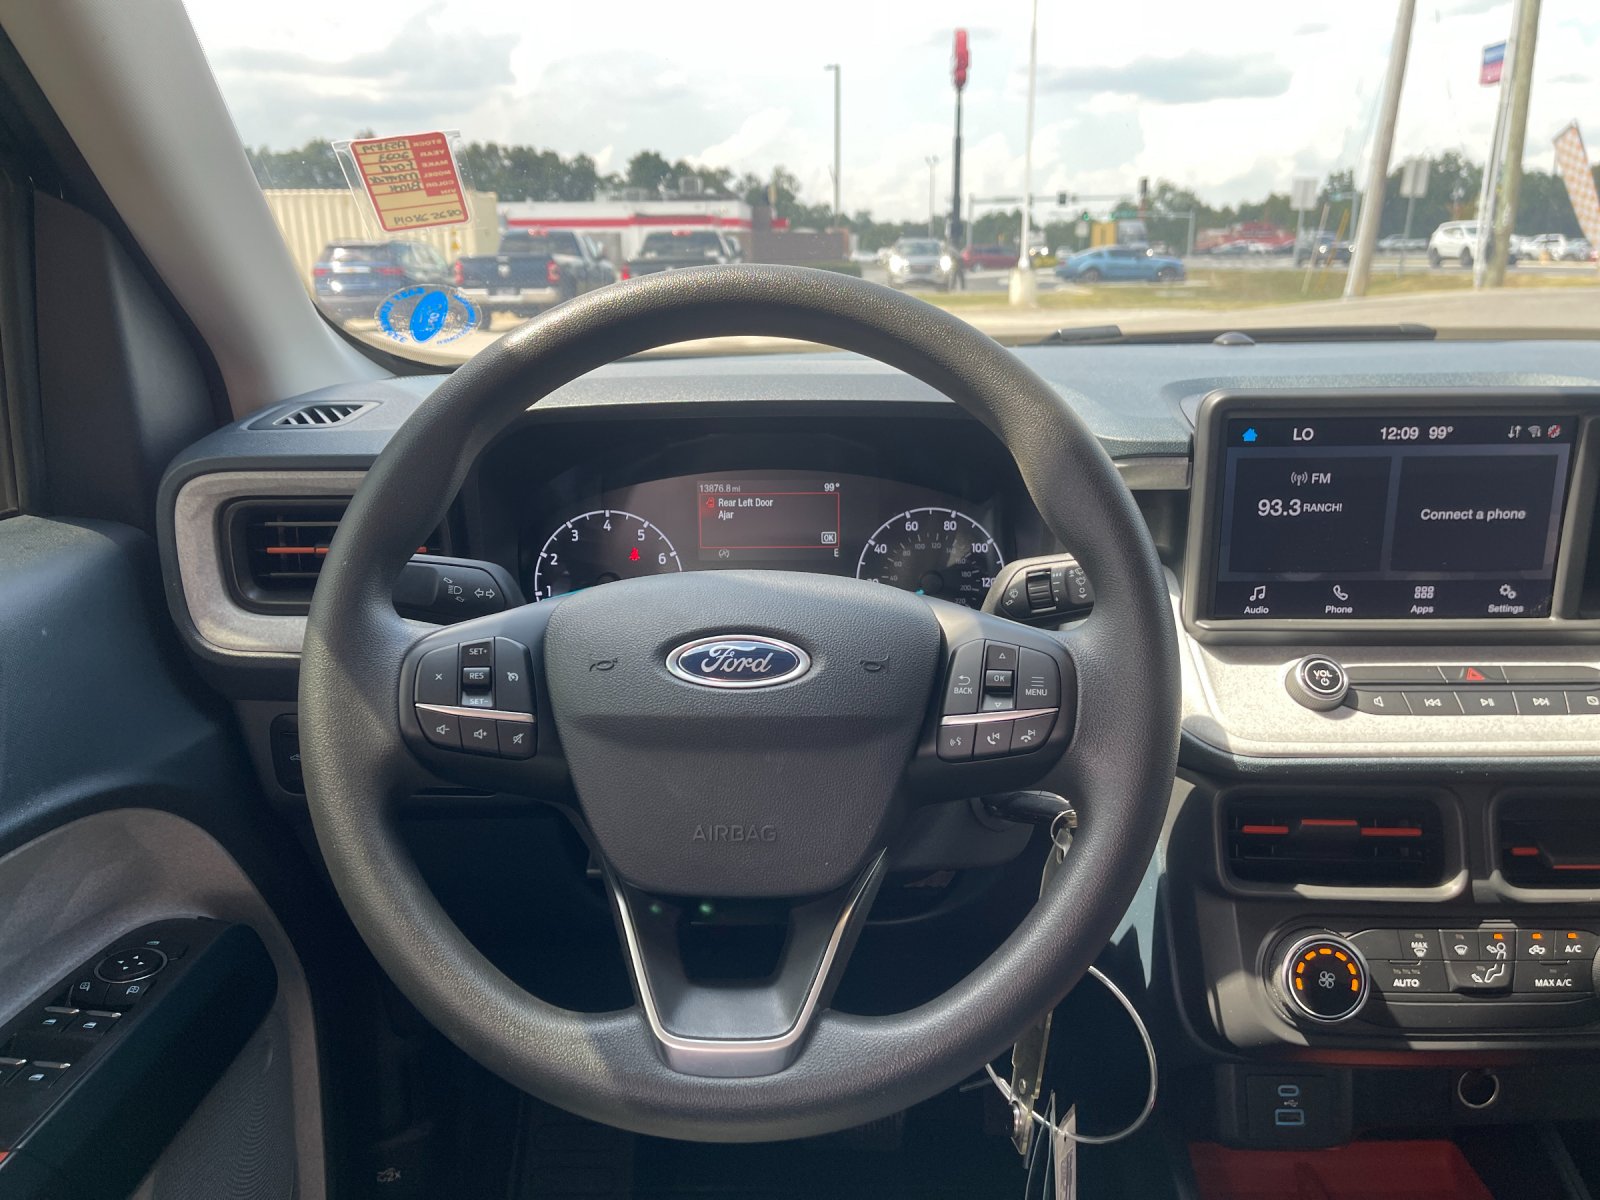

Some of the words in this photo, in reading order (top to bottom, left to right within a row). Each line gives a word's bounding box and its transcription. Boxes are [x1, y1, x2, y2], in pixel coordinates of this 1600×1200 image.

[1293, 428, 1314, 441] LO
[1380, 427, 1419, 440] 12:09
[1311, 473, 1331, 484] FM
[700, 484, 731, 492] 13876.8
[718, 498, 736, 506] Rear
[738, 498, 753, 506] Left
[756, 498, 773, 506] Door
[1258, 499, 1301, 516] 93.3
[1303, 503, 1342, 512] RANCH!
[718, 510, 734, 520] Ajar
[1420, 508, 1473, 520] Connect
[1476, 510, 1484, 520] a
[1486, 508, 1526, 522] phone
[603, 520, 611, 531] 4
[905, 521, 918, 531] 60
[944, 521, 957, 530] 80
[571, 530, 578, 541] 3
[638, 529, 645, 540] 5
[834, 548, 839, 557] E
[874, 544, 887, 554] 40
[972, 543, 988, 552] 100
[550, 554, 558, 565] 2
[658, 553, 666, 564] 6
[546, 586, 551, 597] 1
[1410, 605, 1434, 614] Apps
[1488, 604, 1524, 614] Settings
[701, 645, 774, 673] Ford
[692, 825, 777, 842] AIRBAG
